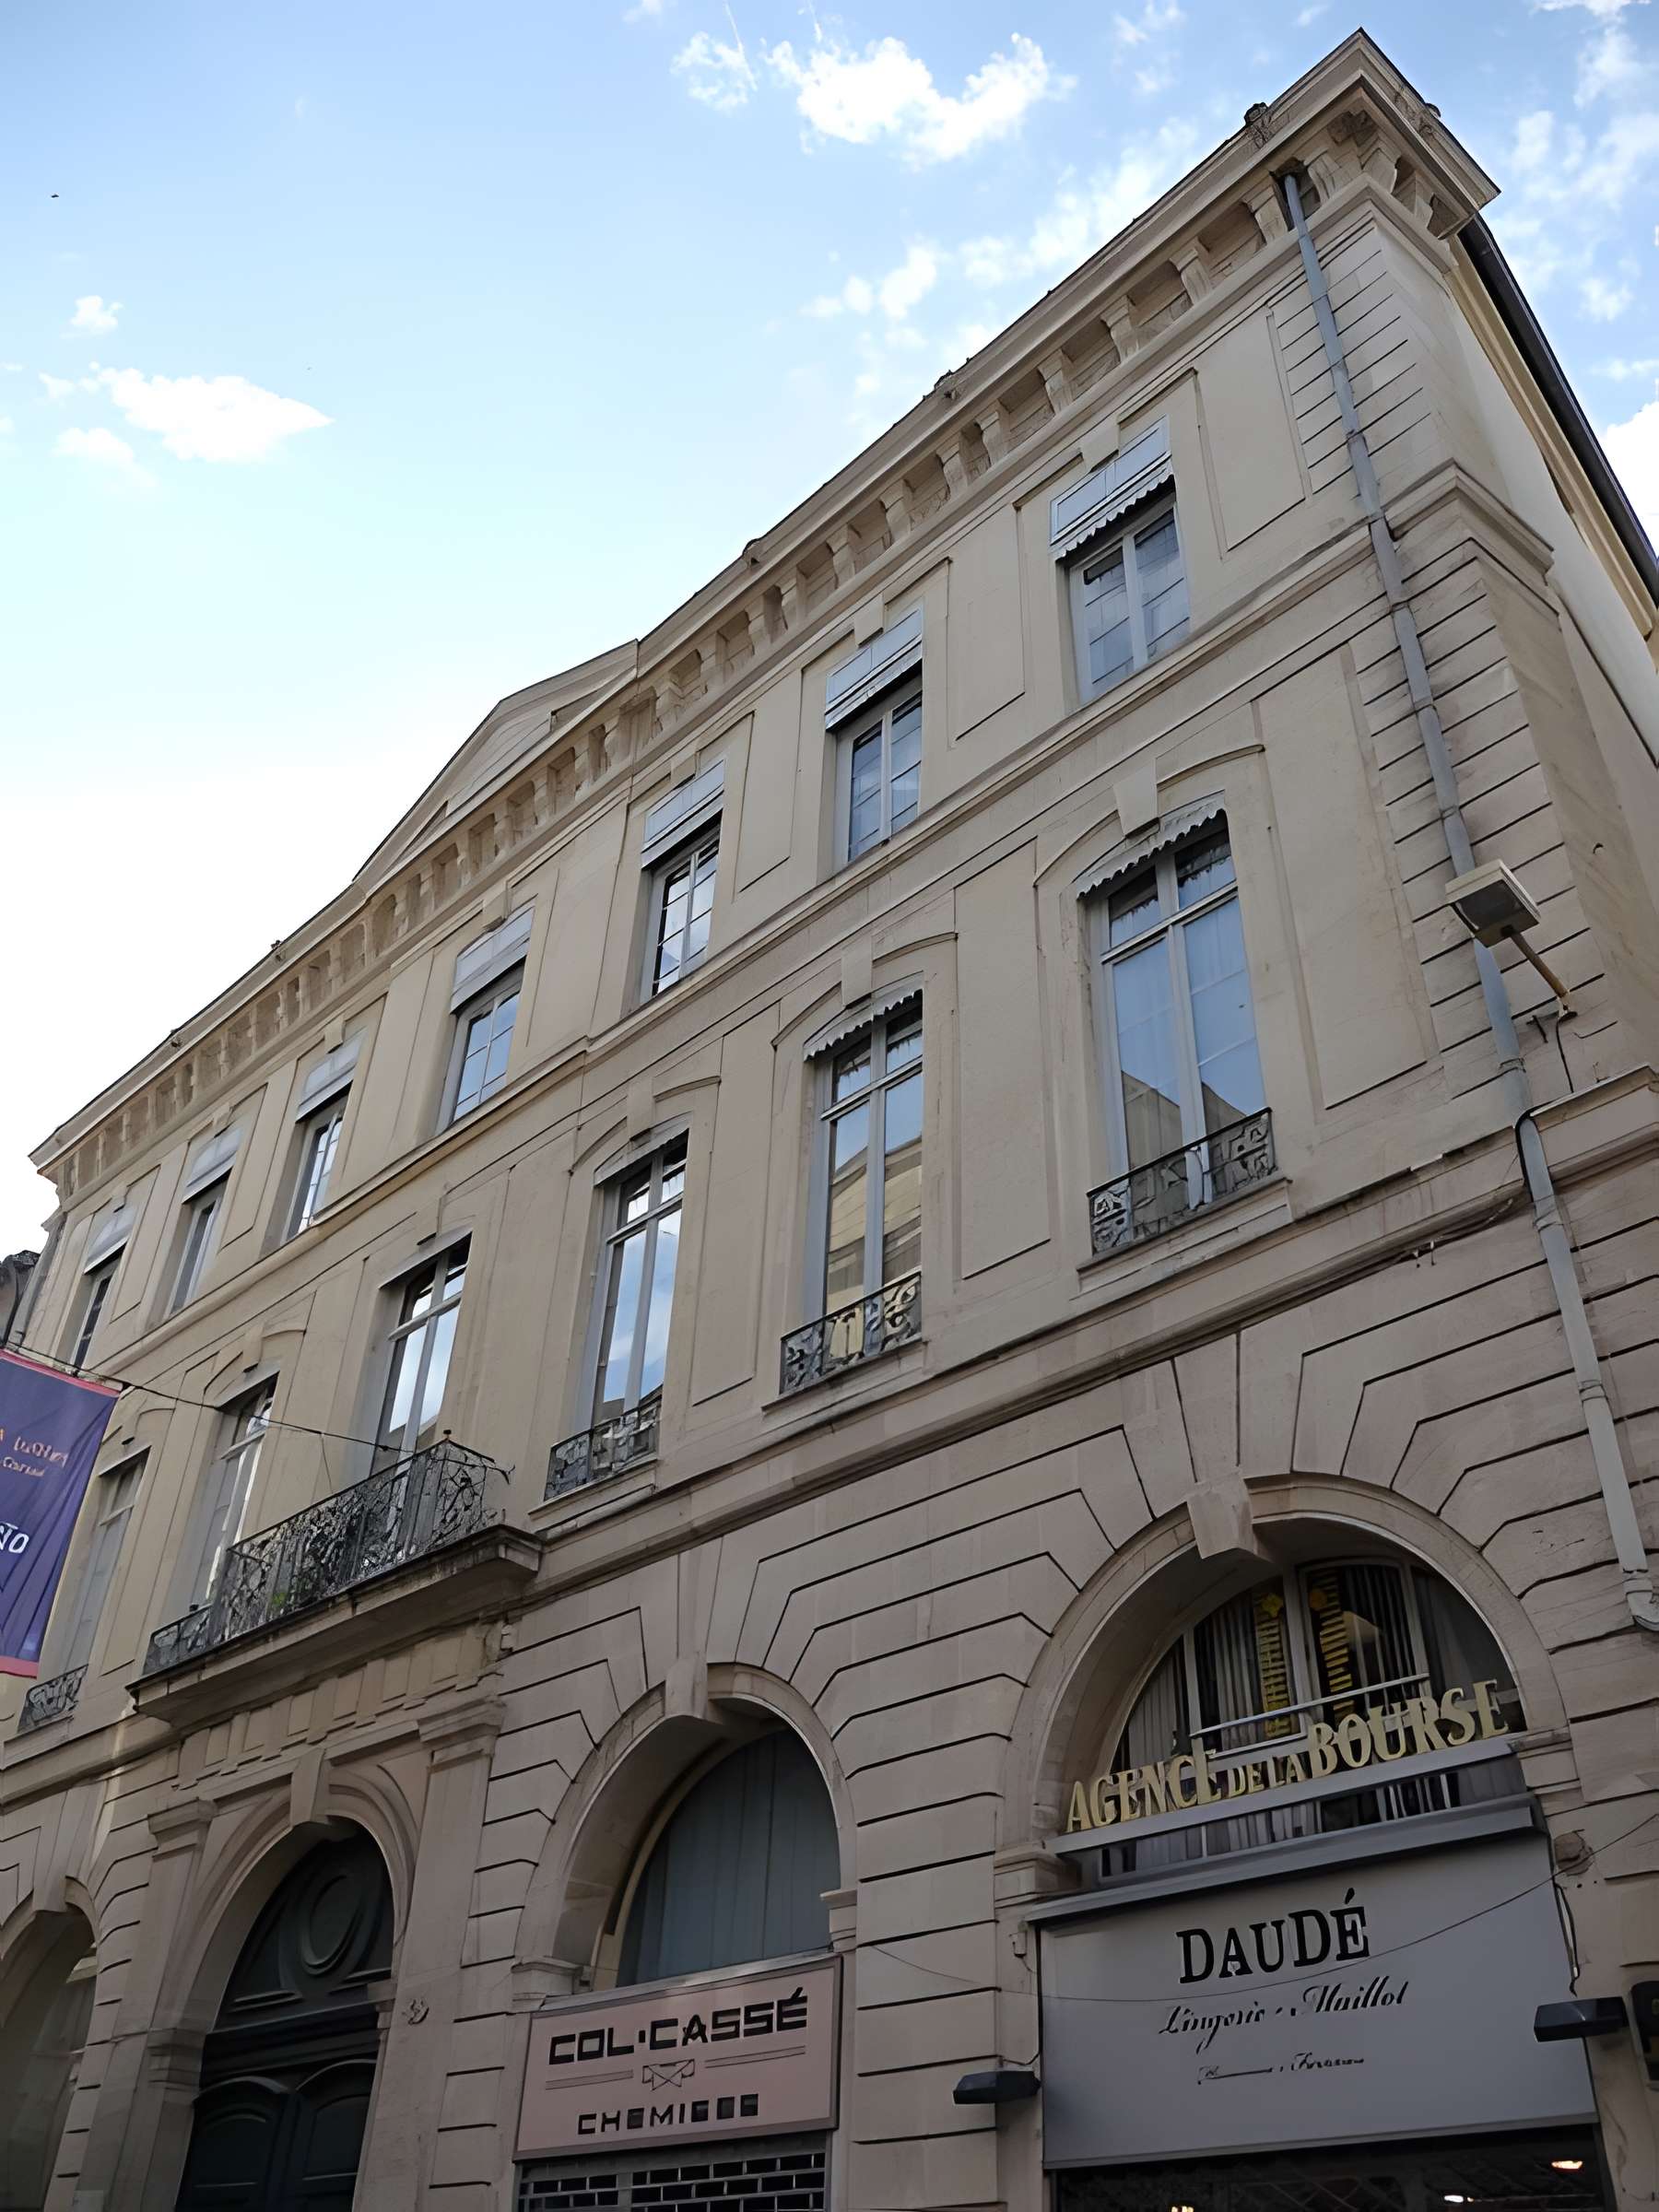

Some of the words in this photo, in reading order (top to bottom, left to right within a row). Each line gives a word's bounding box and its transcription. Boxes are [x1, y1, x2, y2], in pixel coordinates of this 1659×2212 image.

[1066, 1737, 1221, 1832] AGENCE
[1227, 1763, 1265, 1798] DE
[1268, 1752, 1308, 1789] LA
[1307, 1678, 1510, 1779] BOURSE
[1175, 1888, 1370, 1984] DAUDÉ
[1290, 1975, 1409, 2017] Maillot
[577, 2093, 759, 2136] CHMI
